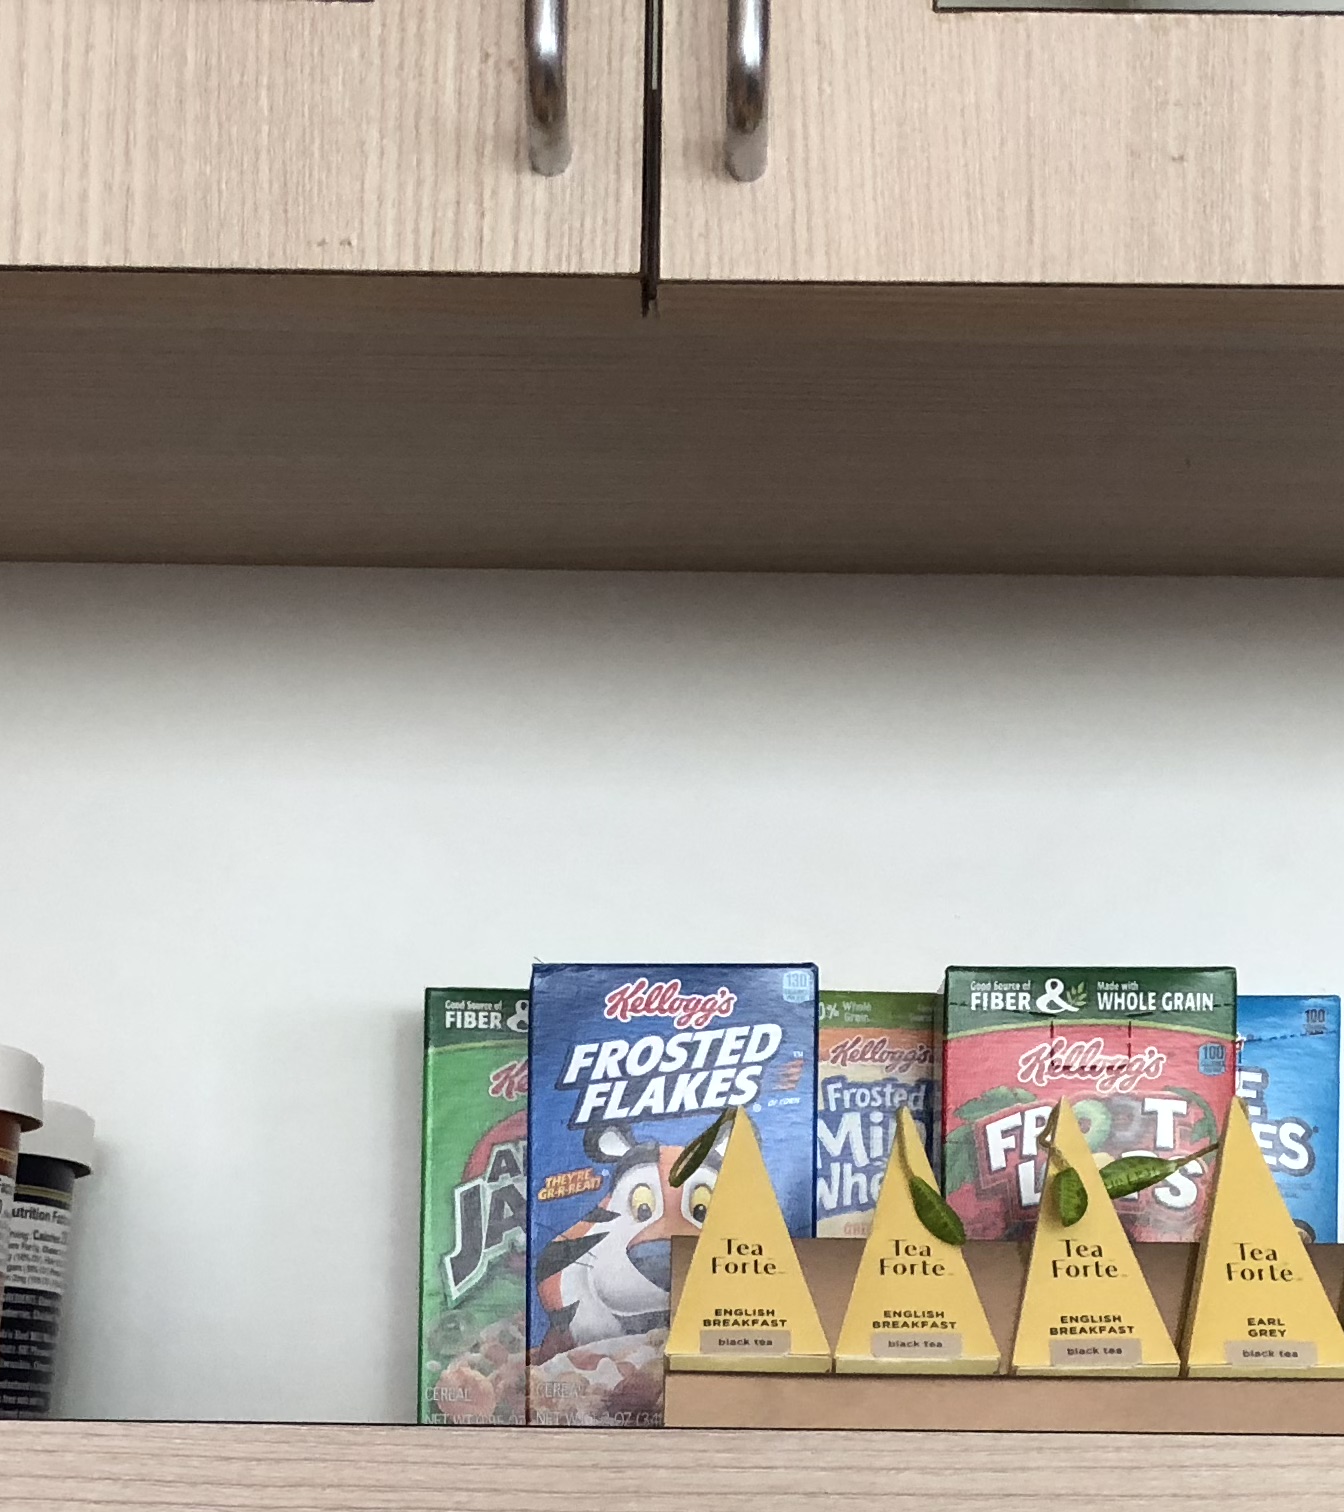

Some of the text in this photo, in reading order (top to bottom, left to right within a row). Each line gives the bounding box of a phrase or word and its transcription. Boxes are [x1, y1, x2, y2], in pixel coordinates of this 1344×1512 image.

[786, 973, 806, 987] 130
[971, 980, 1031, 990] Good Source of
[1097, 981, 1139, 990] Made with
[971, 992, 1030, 1010] FIBER
[1036, 978, 1079, 1013] &
[1097, 992, 1214, 1011] WHOLE GRAIN
[604, 978, 737, 1029] Kellogg's
[445, 1011, 502, 1029] FIBER
[1305, 1008, 1326, 1024] 100
[562, 1023, 783, 1084] FROSTED
[829, 1036, 933, 1073] Kellogg's
[1202, 1045, 1224, 1060] 100
[1017, 1037, 1166, 1094] Kellogg's
[575, 1065, 763, 1124] FLAKES
[827, 1082, 926, 1111] Frosted
[12, 1206, 51, 1221] utrition
[720, 1238, 764, 1256] Tea
[889, 1239, 932, 1257] Tea
[1059, 1239, 1104, 1258] Tea
[1234, 1242, 1279, 1261] Tea
[714, 1309, 775, 1317] ENGLISH
[883, 1310, 945, 1319] ENGLISH
[1060, 1315, 1122, 1324] ENGLISH
[702, 1319, 787, 1328] BREAKFAST
[872, 1321, 957, 1330] BREAKFAST
[1247, 1317, 1285, 1327] EARL
[1049, 1325, 1134, 1335] BREAKFAST
[1248, 1329, 1287, 1338] GREY
[718, 1337, 773, 1346] black tea
[888, 1340, 943, 1348] black tea
[1067, 1347, 1123, 1356] black tea
[1242, 1349, 1298, 1358] black tea
[425, 1387, 470, 1401] CEREAL
[425, 1414, 446, 1425] NET
[536, 1411, 560, 1425] NET
[614, 1411, 632, 1425] OZ
